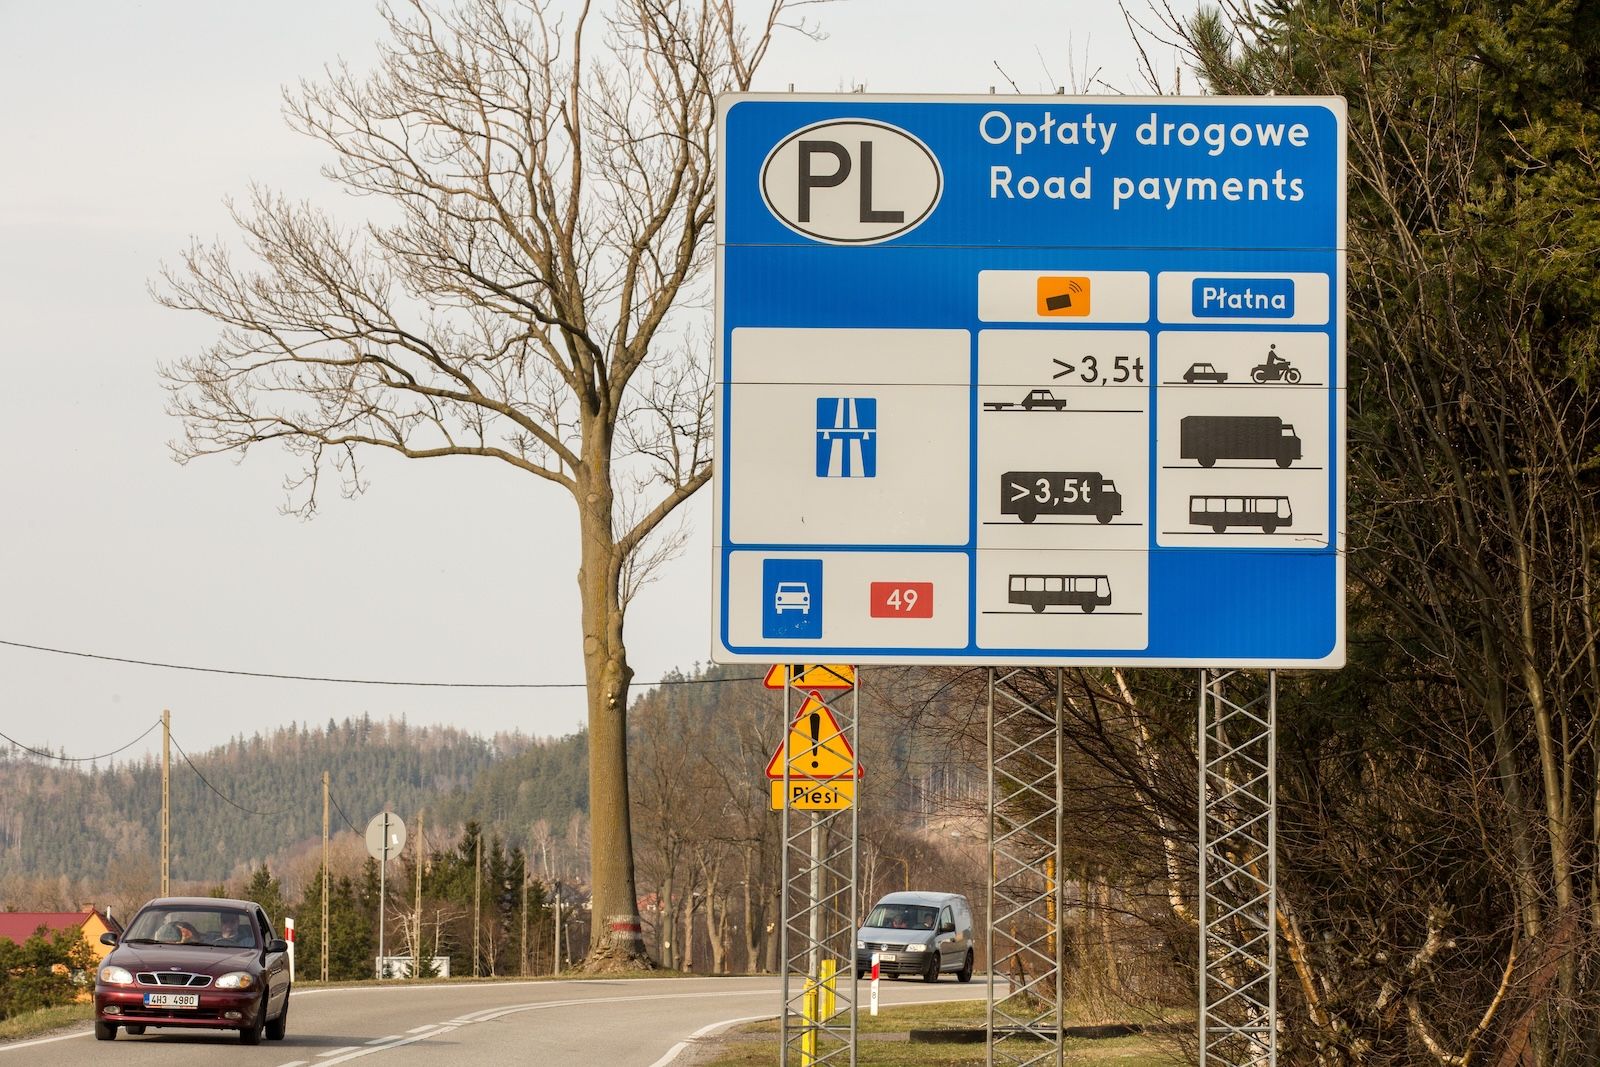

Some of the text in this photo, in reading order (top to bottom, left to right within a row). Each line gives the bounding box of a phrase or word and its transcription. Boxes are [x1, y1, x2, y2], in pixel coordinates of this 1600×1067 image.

[979, 110, 1309, 157] Opłaty drogowe
[798, 140, 904, 223] PL
[991, 165, 1305, 210] Road payments
[1203, 287, 1286, 309] Płatna
[886, 589, 918, 612] 49
[793, 786, 838, 804] Piesi
[151, 995, 167, 1004] 4H3
[173, 995, 195, 1005] 4980
